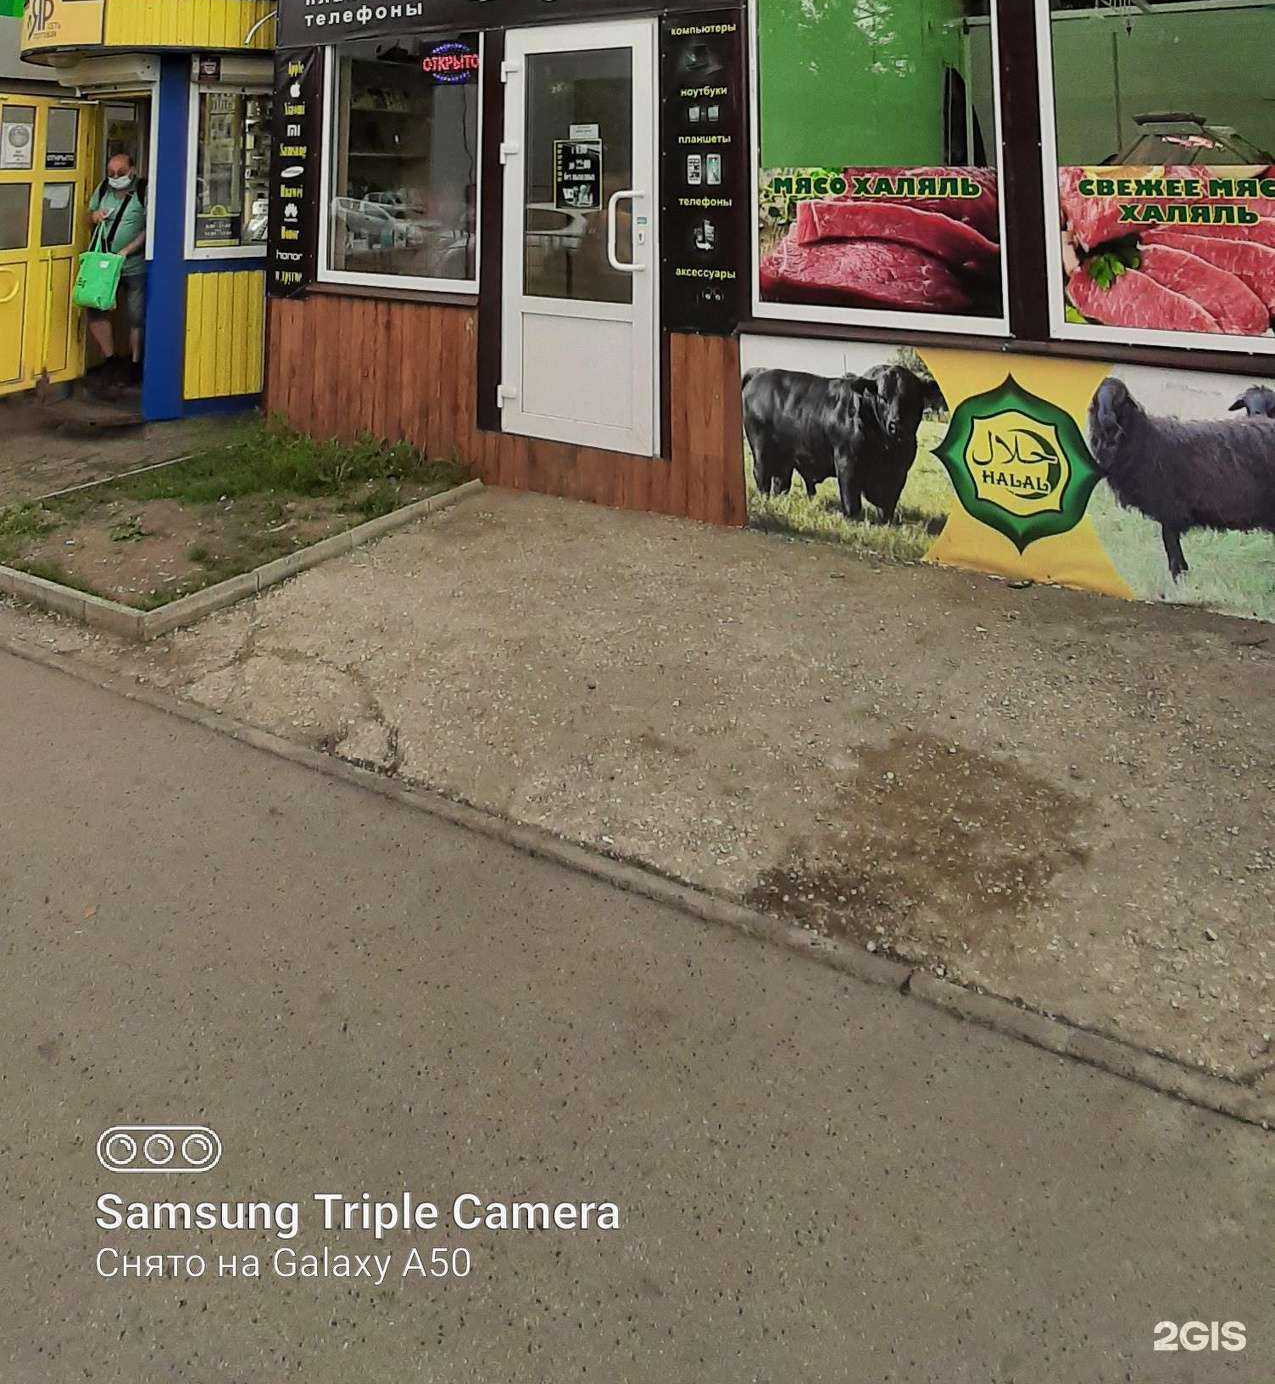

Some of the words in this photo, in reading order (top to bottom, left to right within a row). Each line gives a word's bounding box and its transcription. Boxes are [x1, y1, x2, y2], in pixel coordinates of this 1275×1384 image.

[305, 2, 423, 28] телефоны
[671, 24, 736, 36] компьютеры
[422, 54, 480, 72] ОТКРЫТО
[680, 86, 728, 98] ноутбуки
[678, 135, 731, 144] планшеты
[773, 176, 844, 198] МЯСО
[852, 176, 982, 199] ХАЛЯЛЬ
[1078, 179, 1202, 197] СВЕЖЕЕ
[1208, 179, 1275, 198] МЯС
[678, 197, 732, 208] телефоны
[1119, 204, 1260, 224] ХАЛЯЛЬ
[276, 249, 303, 261] honor
[675, 267, 736, 280] аксессуары
[972, 429, 1058, 466] حلال
[982, 470, 1049, 491] HALAL
